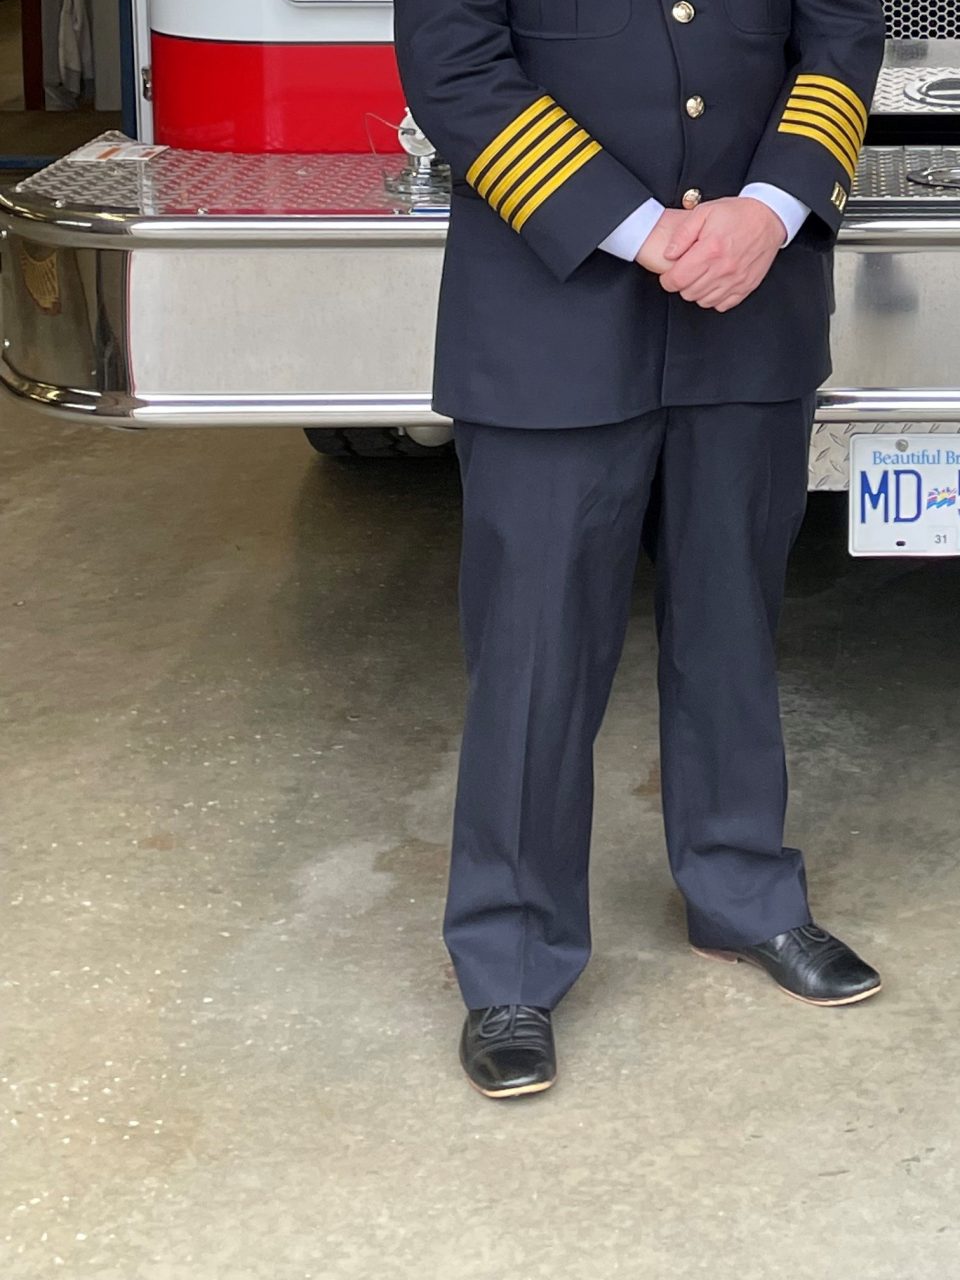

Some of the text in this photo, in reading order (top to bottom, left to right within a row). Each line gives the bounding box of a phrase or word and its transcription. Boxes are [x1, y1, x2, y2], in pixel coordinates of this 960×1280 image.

[872, 450, 940, 465] Beautiful
[860, 470, 922, 524] MD
[934, 534, 948, 545] 31
